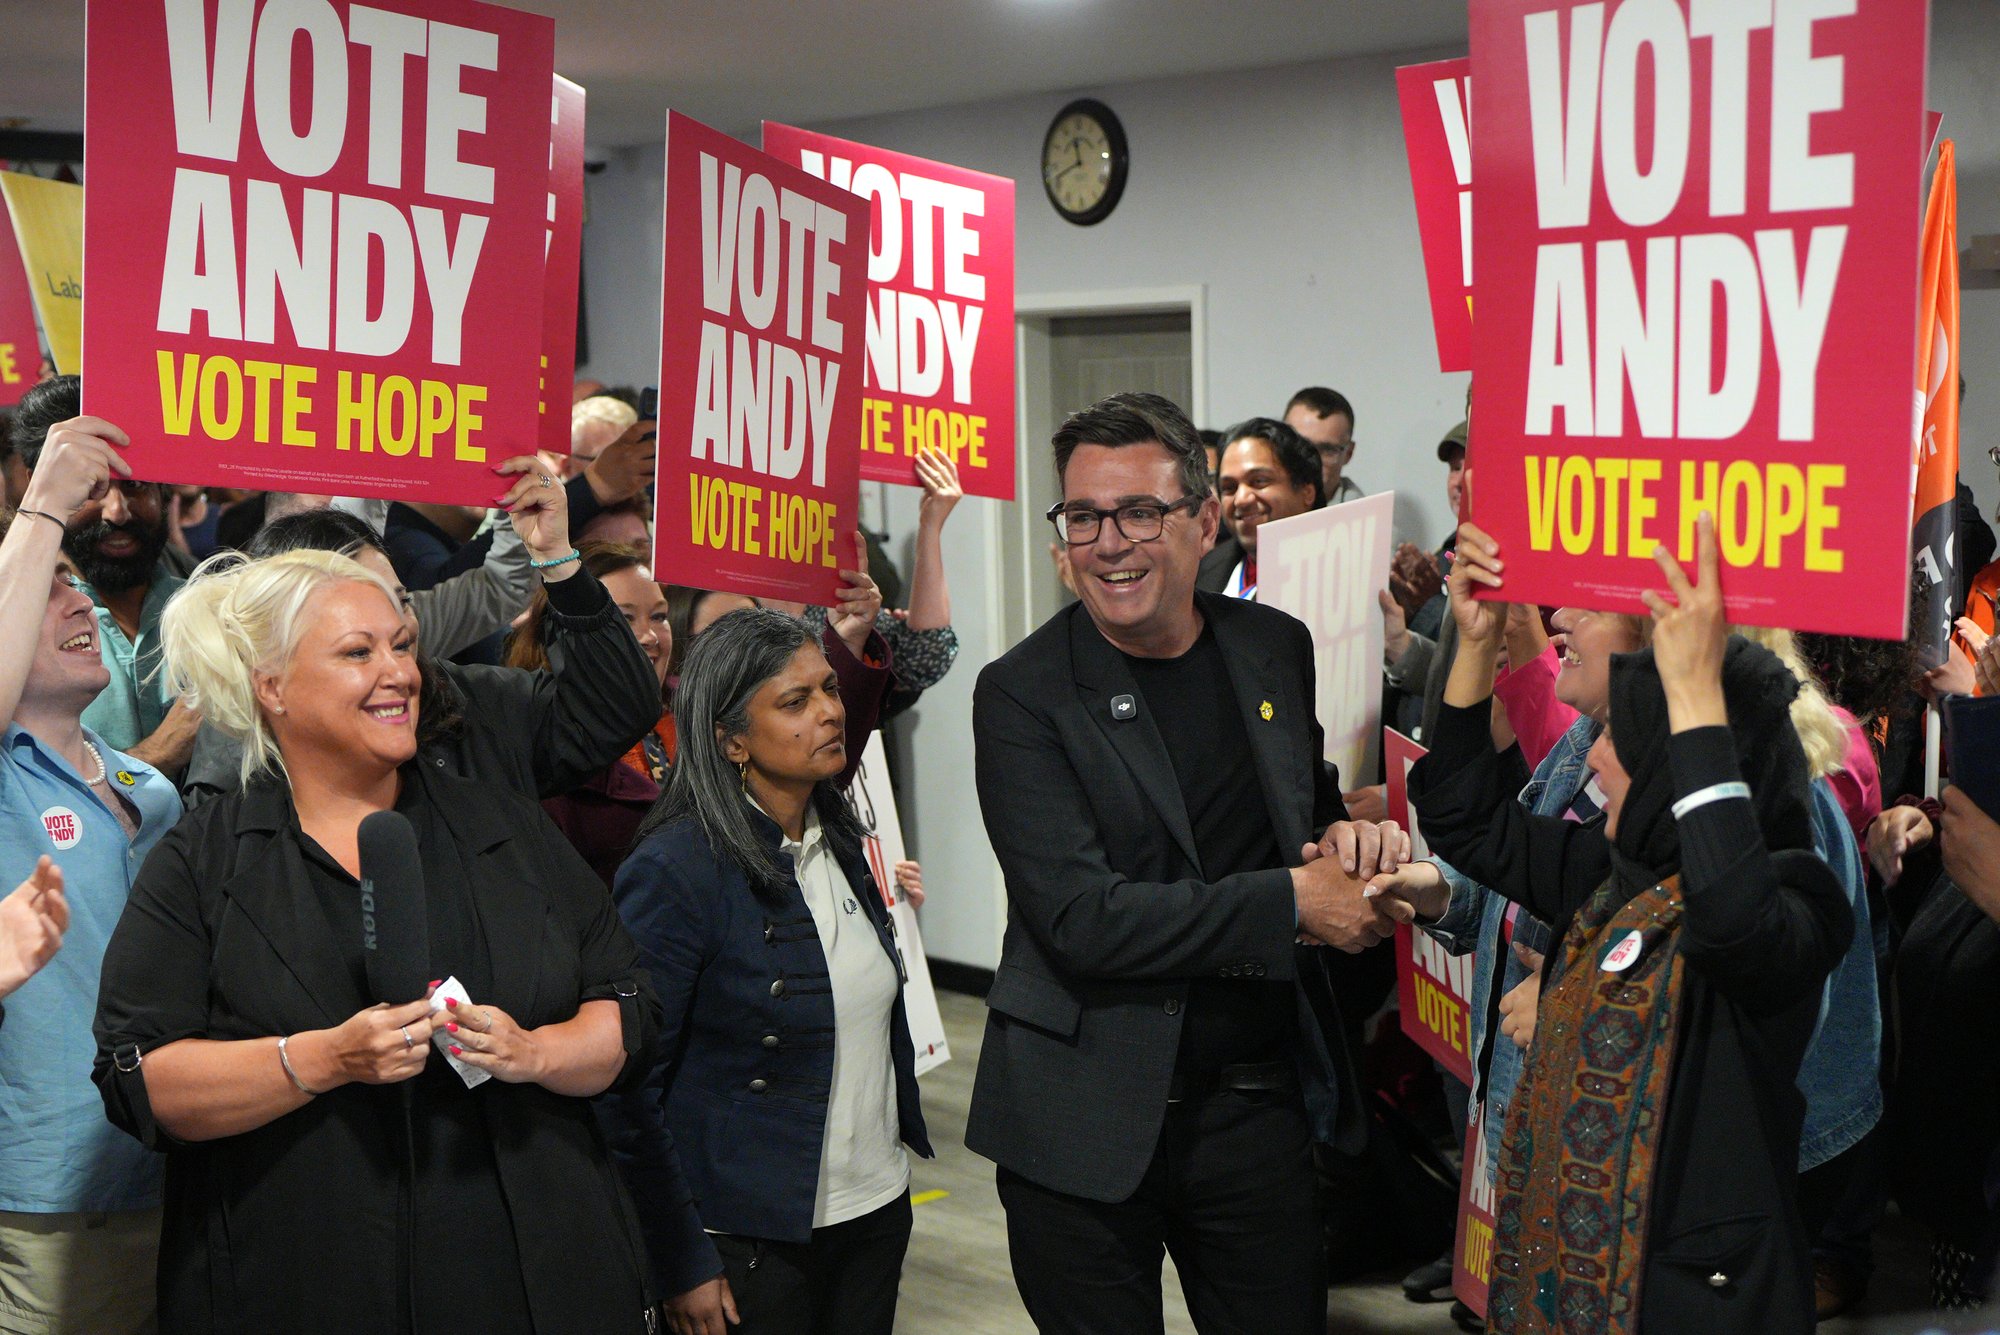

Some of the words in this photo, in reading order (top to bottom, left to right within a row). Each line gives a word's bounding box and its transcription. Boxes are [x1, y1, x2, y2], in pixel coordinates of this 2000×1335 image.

[165, 0, 498, 204] VOTE
[1524, 0, 1857, 229] VOTE
[157, 168, 489, 366] ANDY
[700, 151, 847, 353] VOTE
[801, 149, 985, 301] OTE
[863, 288, 984, 404] NDY
[1525, 225, 1848, 441] ANDY
[157, 350, 317, 447] VOTE
[337, 371, 487, 462] HOPE
[691, 320, 840, 487] ANDY
[861, 398, 894, 454] TE
[903, 404, 987, 469] HOPE
[690, 473, 761, 555] VOTE
[769, 491, 837, 568] HOPE
[1525, 456, 1662, 559] VOTE
[1677, 460, 1846, 573] HOPE
[44, 814, 74, 830] VOTE
[1413, 971, 1463, 1053] VOTE
[1464, 1213, 1494, 1285] VOTE
